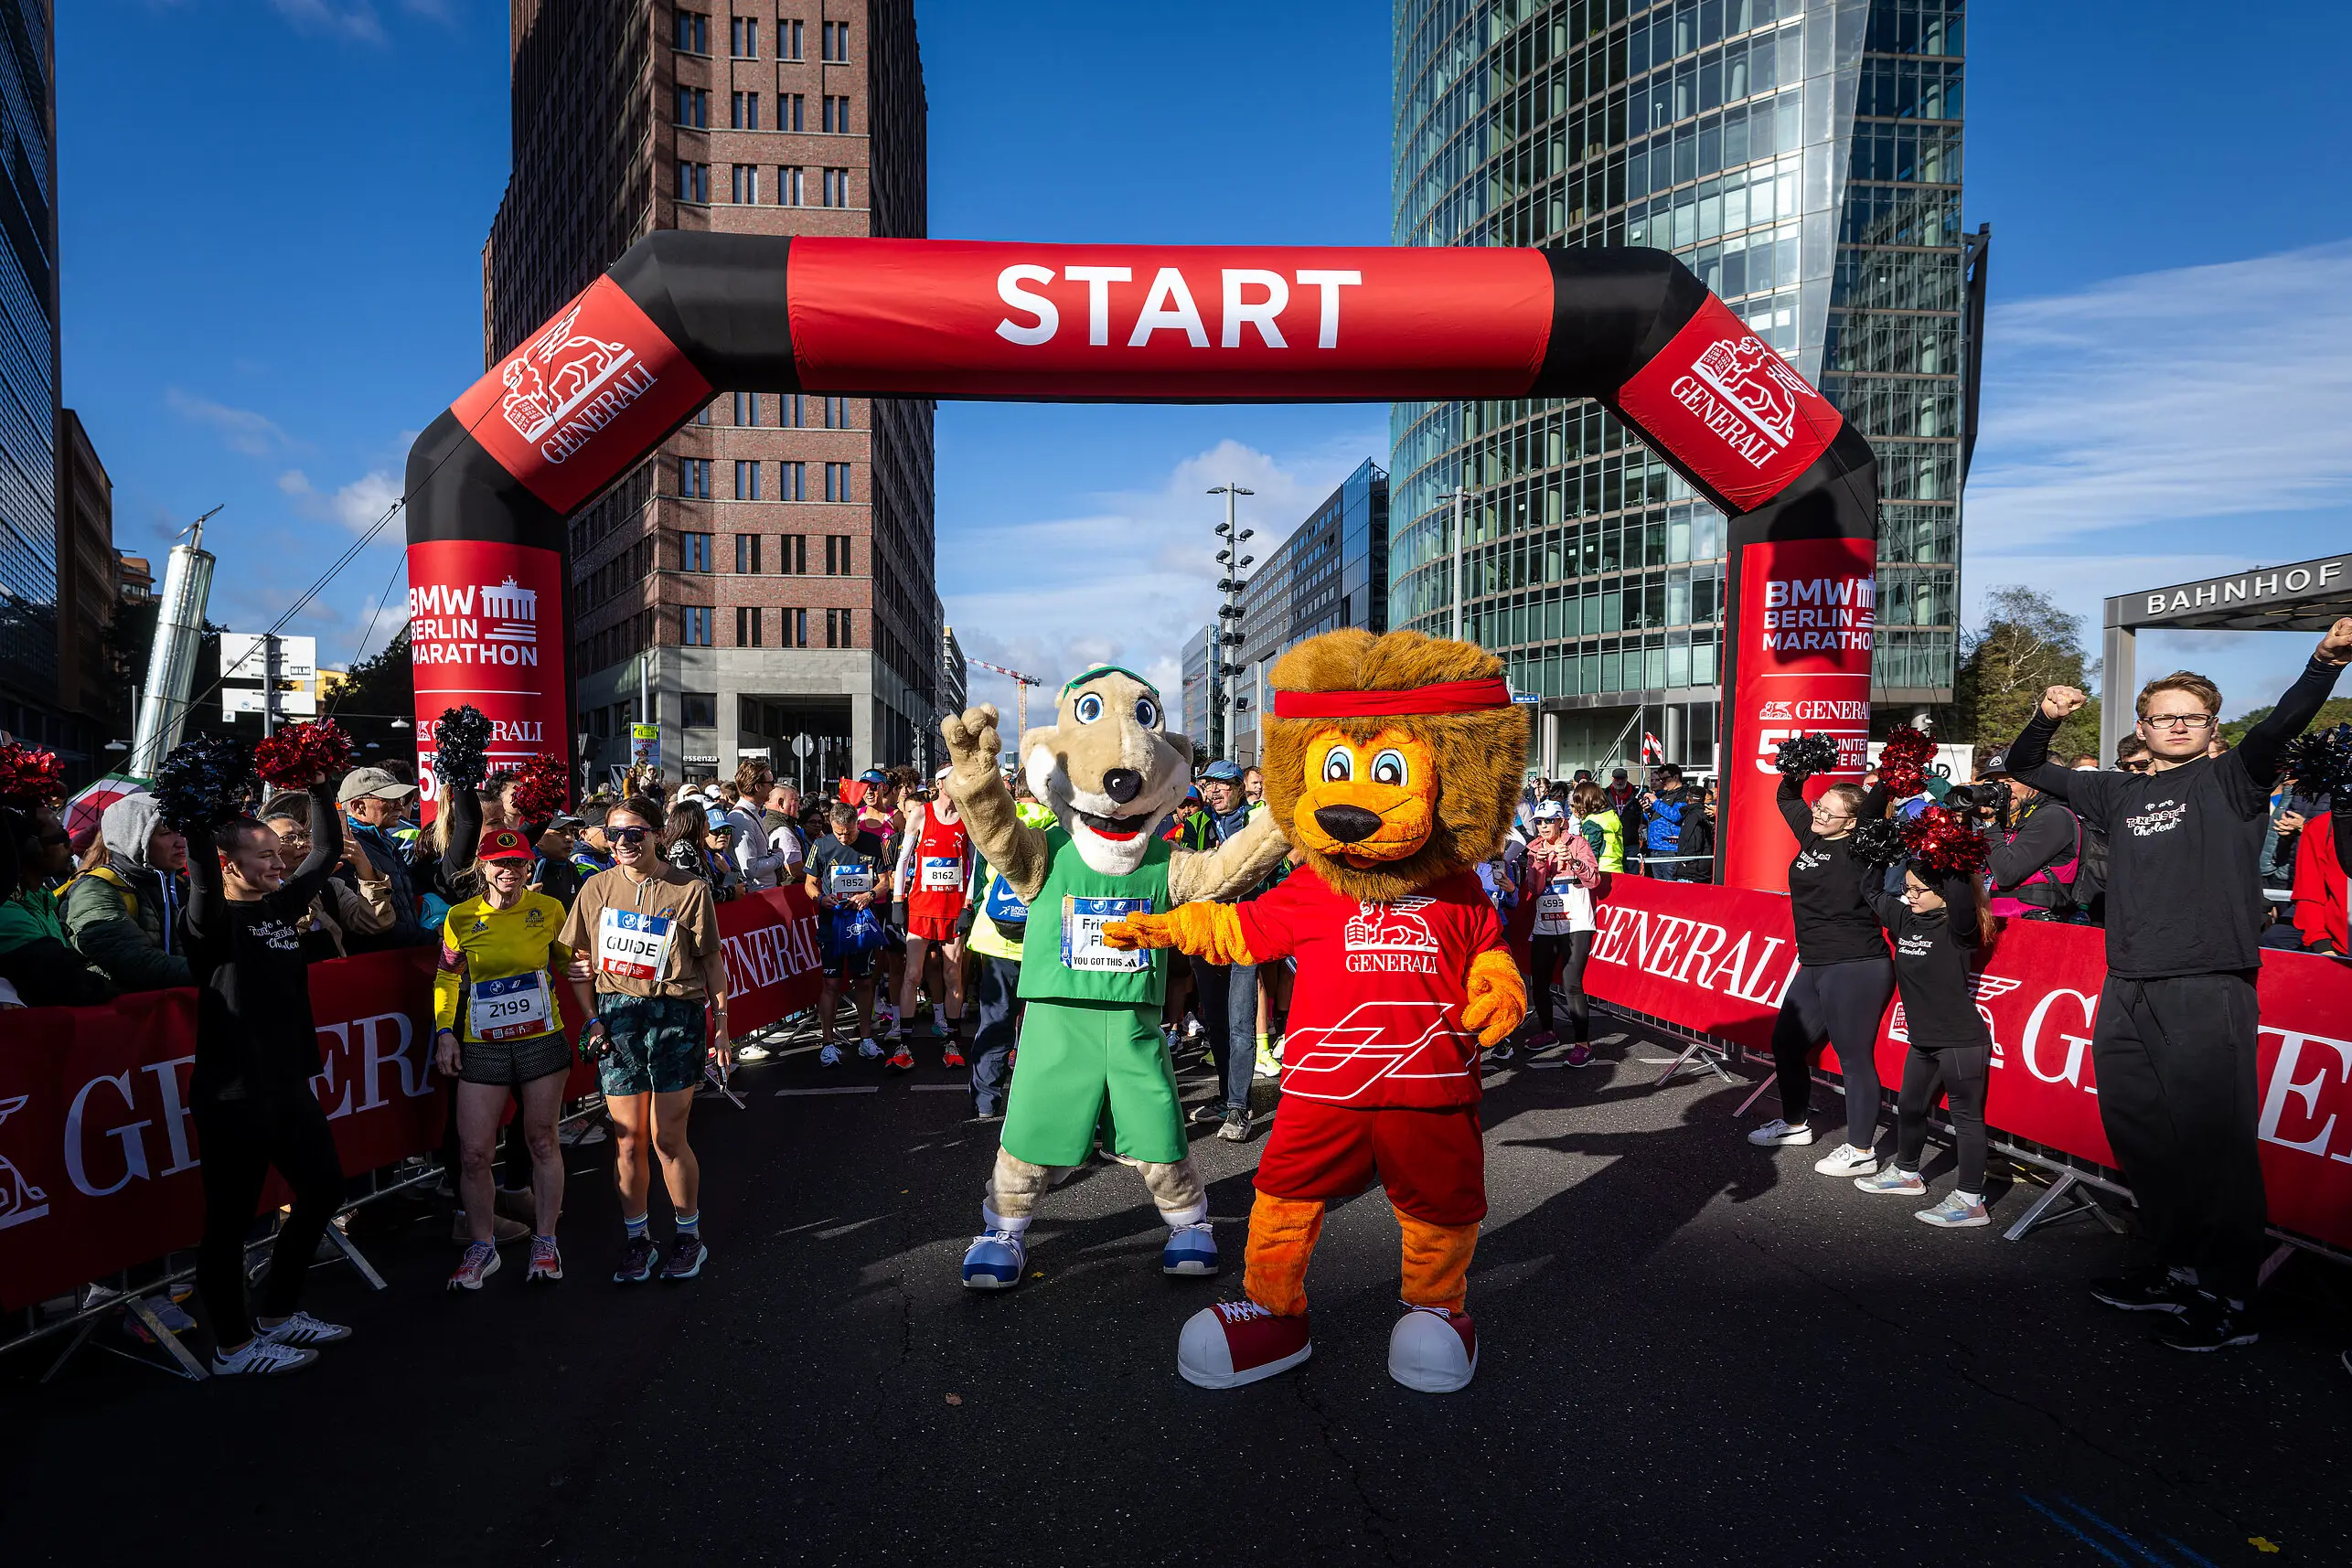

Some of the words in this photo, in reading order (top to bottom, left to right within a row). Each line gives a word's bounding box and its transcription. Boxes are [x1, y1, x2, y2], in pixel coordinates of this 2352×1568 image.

[995, 263, 1363, 348] START
[540, 359, 657, 464] GENERALI
[1670, 375, 1779, 470] GENERALI
[1765, 580, 1854, 608] BMW
[2147, 562, 2343, 615] BAHNHOF
[410, 584, 476, 617] BMW
[412, 619, 478, 640] BERLIN
[1764, 609, 1853, 629] BERLIN
[1762, 631, 1874, 651] MARATHO
[412, 643, 538, 667] MARATHON
[290, 666, 311, 676] MLM
[840, 878, 864, 887] 1852
[932, 870, 954, 880] 8162
[1543, 899, 1565, 908] 4593
[606, 935, 658, 958] GUIDE
[1074, 957, 1088, 965] YOU
[1091, 957, 1106, 966] GOT
[1107, 957, 1123, 966] THIS
[1345, 954, 1438, 975] GENERALI
[489, 997, 530, 1019] 2199
